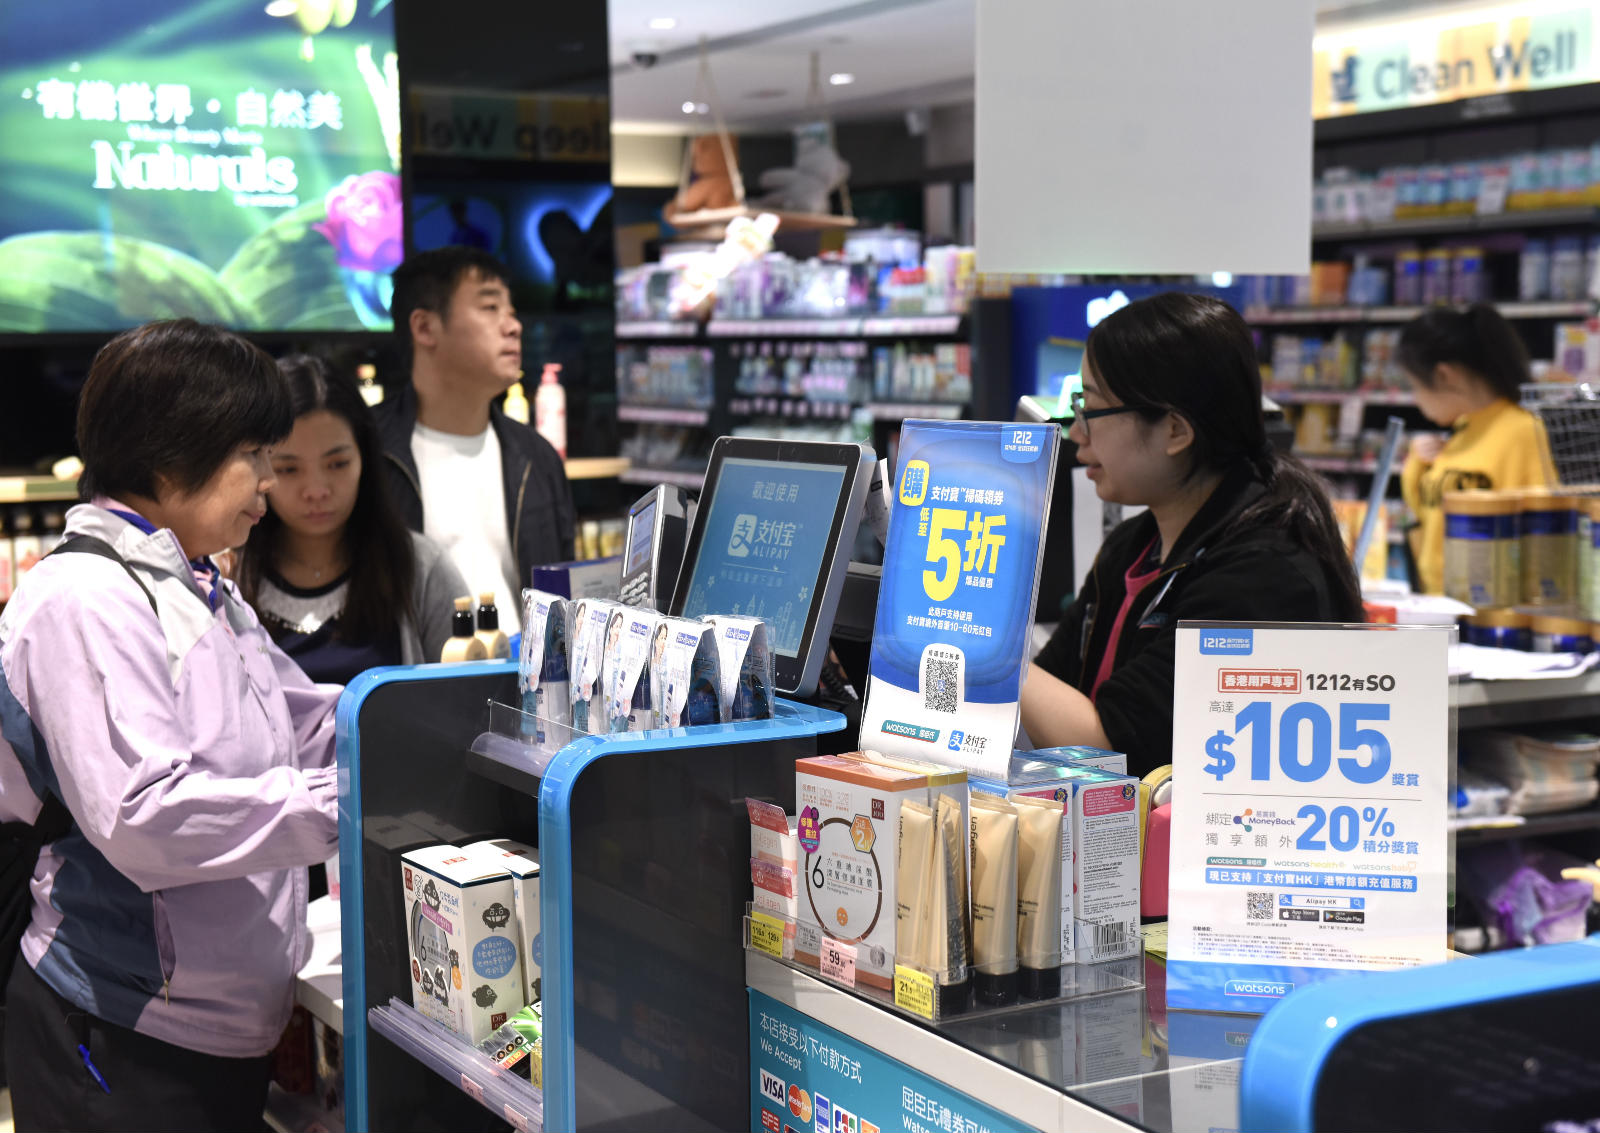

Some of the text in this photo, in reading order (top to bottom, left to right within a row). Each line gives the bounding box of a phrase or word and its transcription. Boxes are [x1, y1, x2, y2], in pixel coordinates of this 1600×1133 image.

[1374, 30, 1576, 98] Clean Well
[91, 140, 298, 193] Naturals
[1013, 431, 1032, 444] 1212
[903, 468, 925, 498] 購
[755, 520, 796, 547] 支付宝
[753, 545, 790, 560] ALIPAY
[923, 508, 1006, 601] 5折
[1204, 638, 1226, 648] 1212
[1306, 674, 1395, 691] 1212有SO
[1209, 701, 1234, 713] 高達
[886, 722, 916, 736] watsons
[964, 734, 987, 749] 支付宝
[1203, 701, 1391, 784] $105
[1392, 773, 1419, 786] 獎賞
[1249, 817, 1296, 826] MoneyBack
[1296, 804, 1395, 852] 20%
[1363, 840, 1419, 854] 積分獎賞
[813, 856, 824, 888] 6
[1234, 983, 1285, 995] watsons
[760, 1012, 862, 1084] 本店接受以下付款方式
[760, 1038, 802, 1072] We Accept
[762, 1072, 785, 1102] VISA
